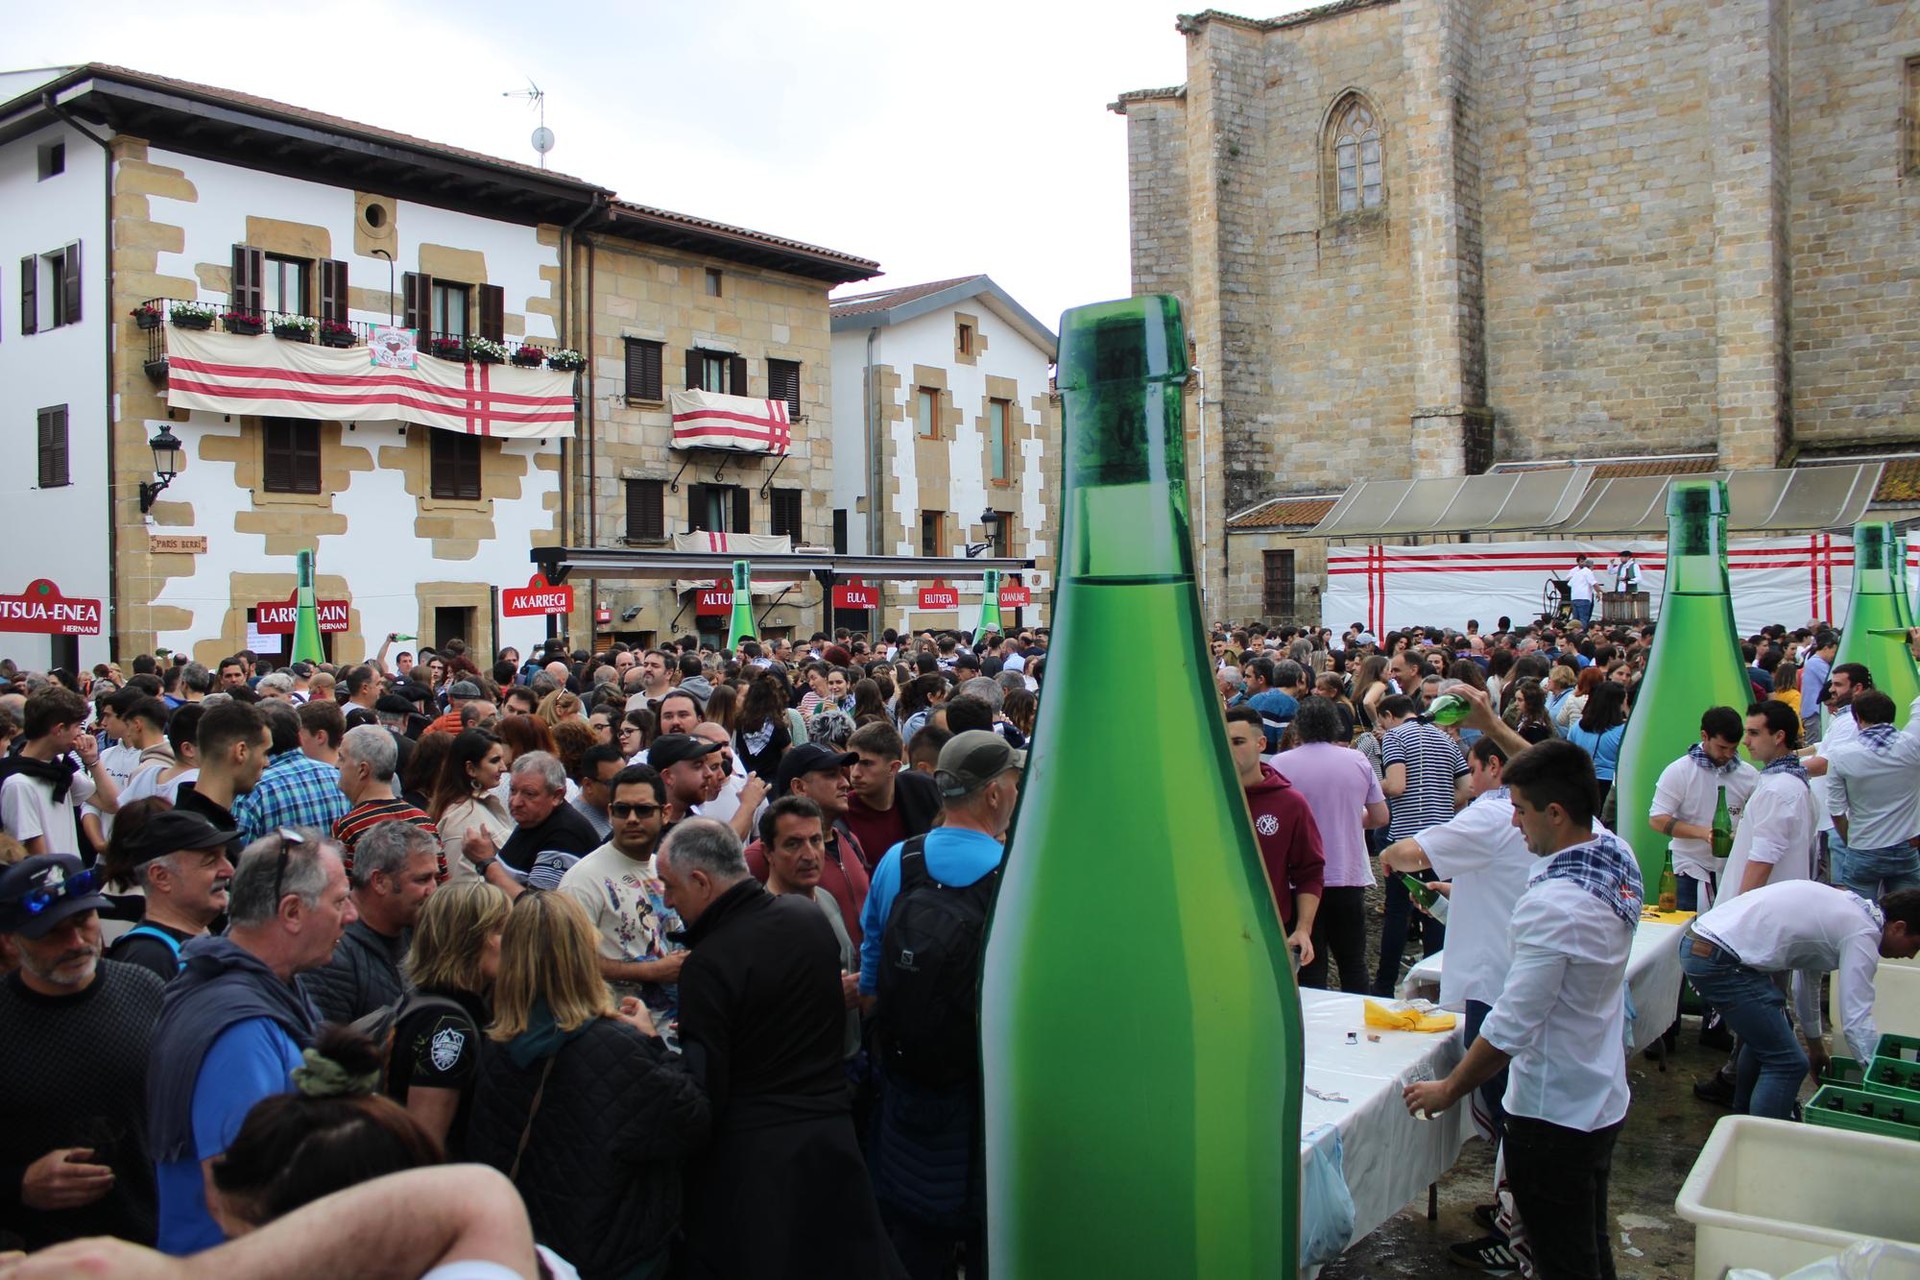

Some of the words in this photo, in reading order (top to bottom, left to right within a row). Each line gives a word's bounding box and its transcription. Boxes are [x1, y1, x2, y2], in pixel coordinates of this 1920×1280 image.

[512, 593, 566, 609] AKARREGI
[847, 592, 866, 603] EULA
[0, 601, 98, 621] TSUA-ENEA
[62, 625, 98, 634] HERNANI
